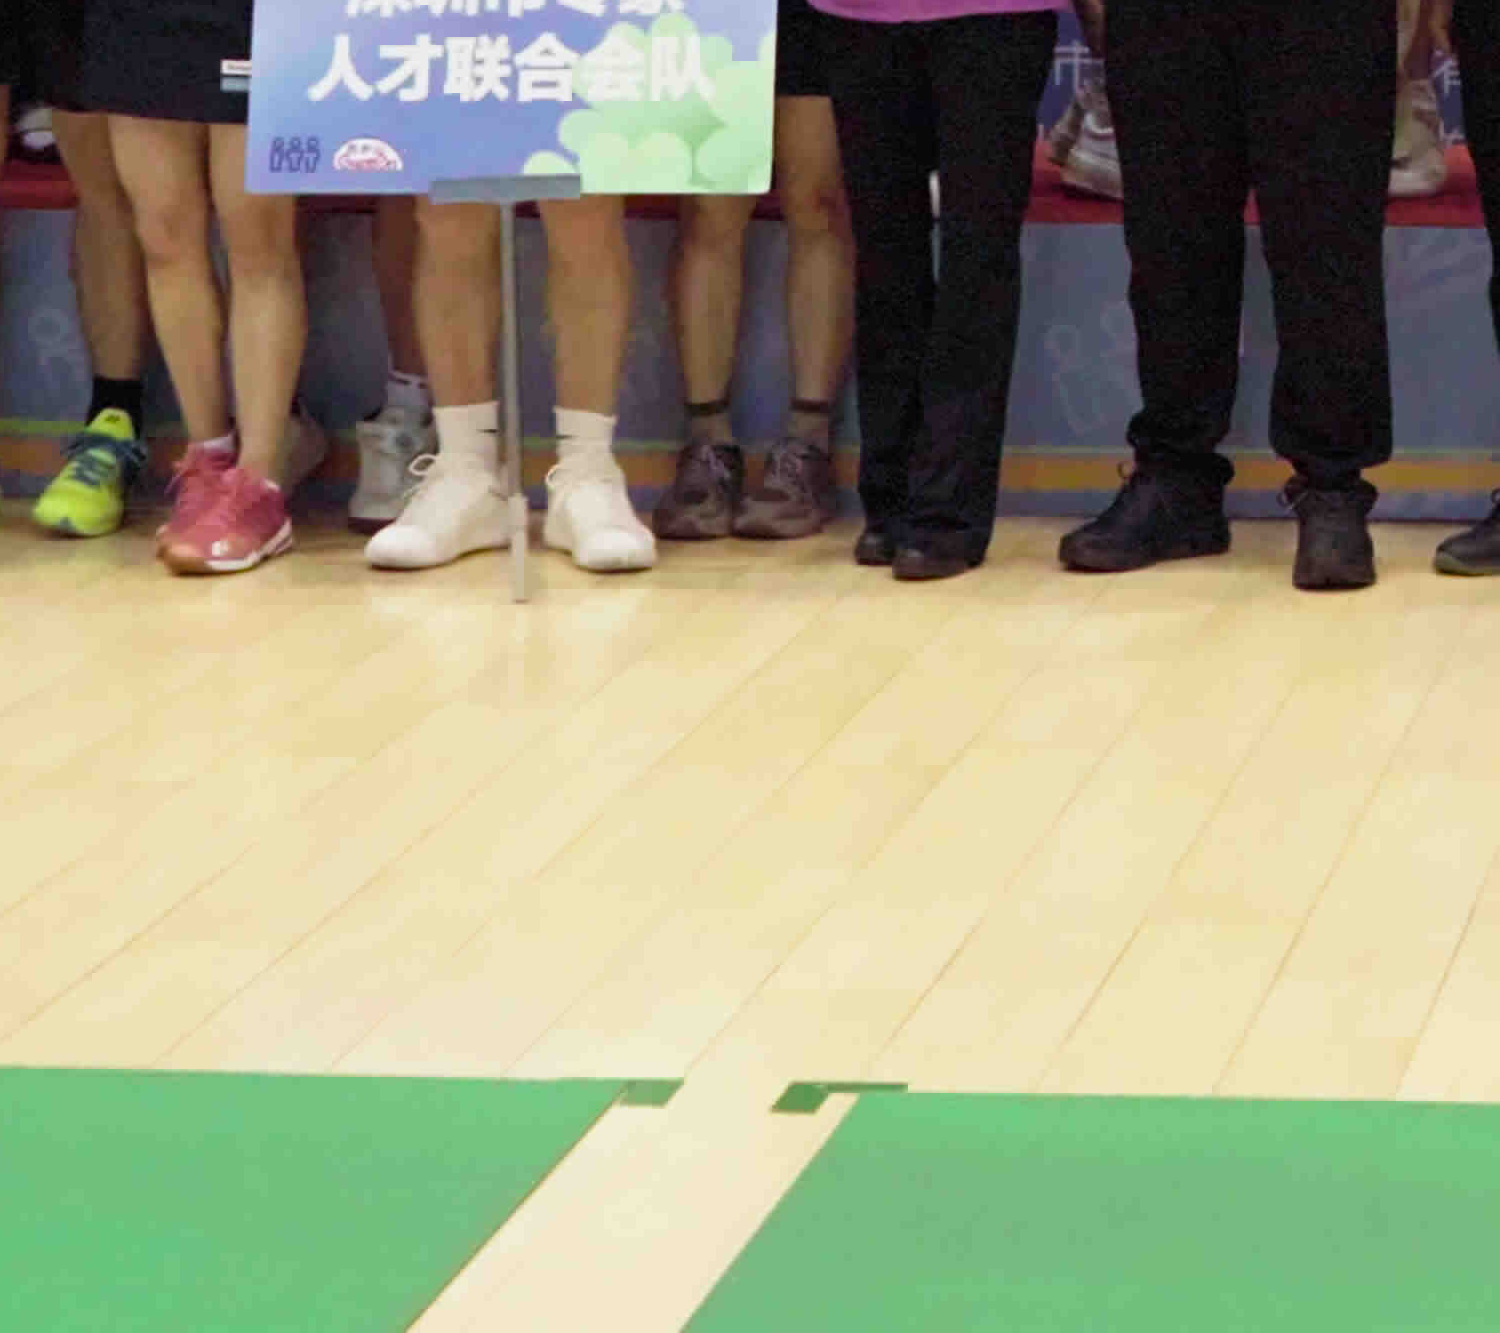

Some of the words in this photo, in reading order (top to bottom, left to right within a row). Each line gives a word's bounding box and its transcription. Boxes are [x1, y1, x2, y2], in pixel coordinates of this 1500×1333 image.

[308, 33, 716, 103] 人才联合会队
